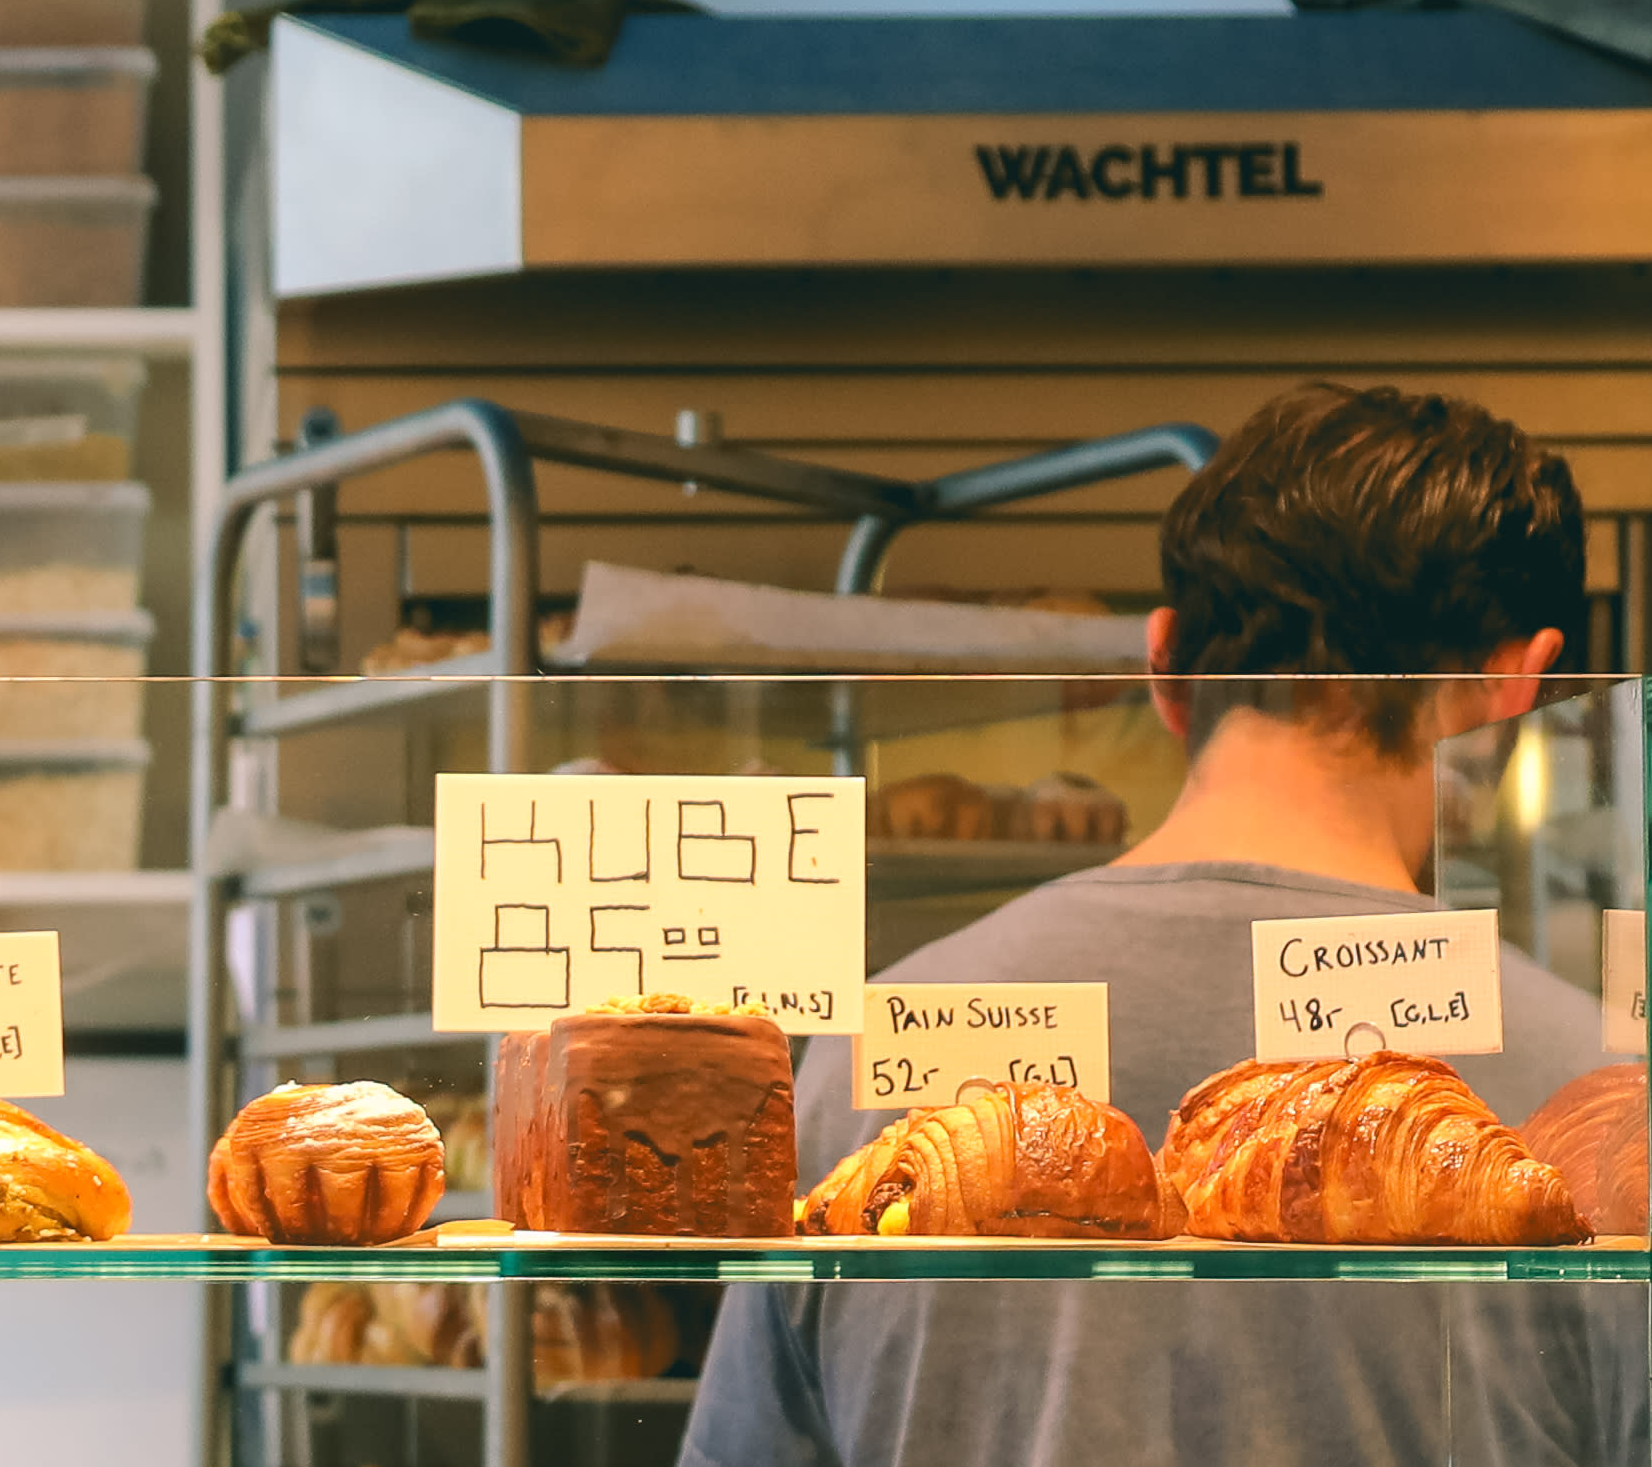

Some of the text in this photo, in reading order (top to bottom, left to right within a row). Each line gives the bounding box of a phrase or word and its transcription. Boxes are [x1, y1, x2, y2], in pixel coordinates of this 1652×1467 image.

[974, 141, 1325, 201] WACHTEL
[481, 793, 840, 885] KUBE
[1279, 937, 1449, 978] CROISSANT
[887, 996, 1058, 1035] PAIN SUISSE
